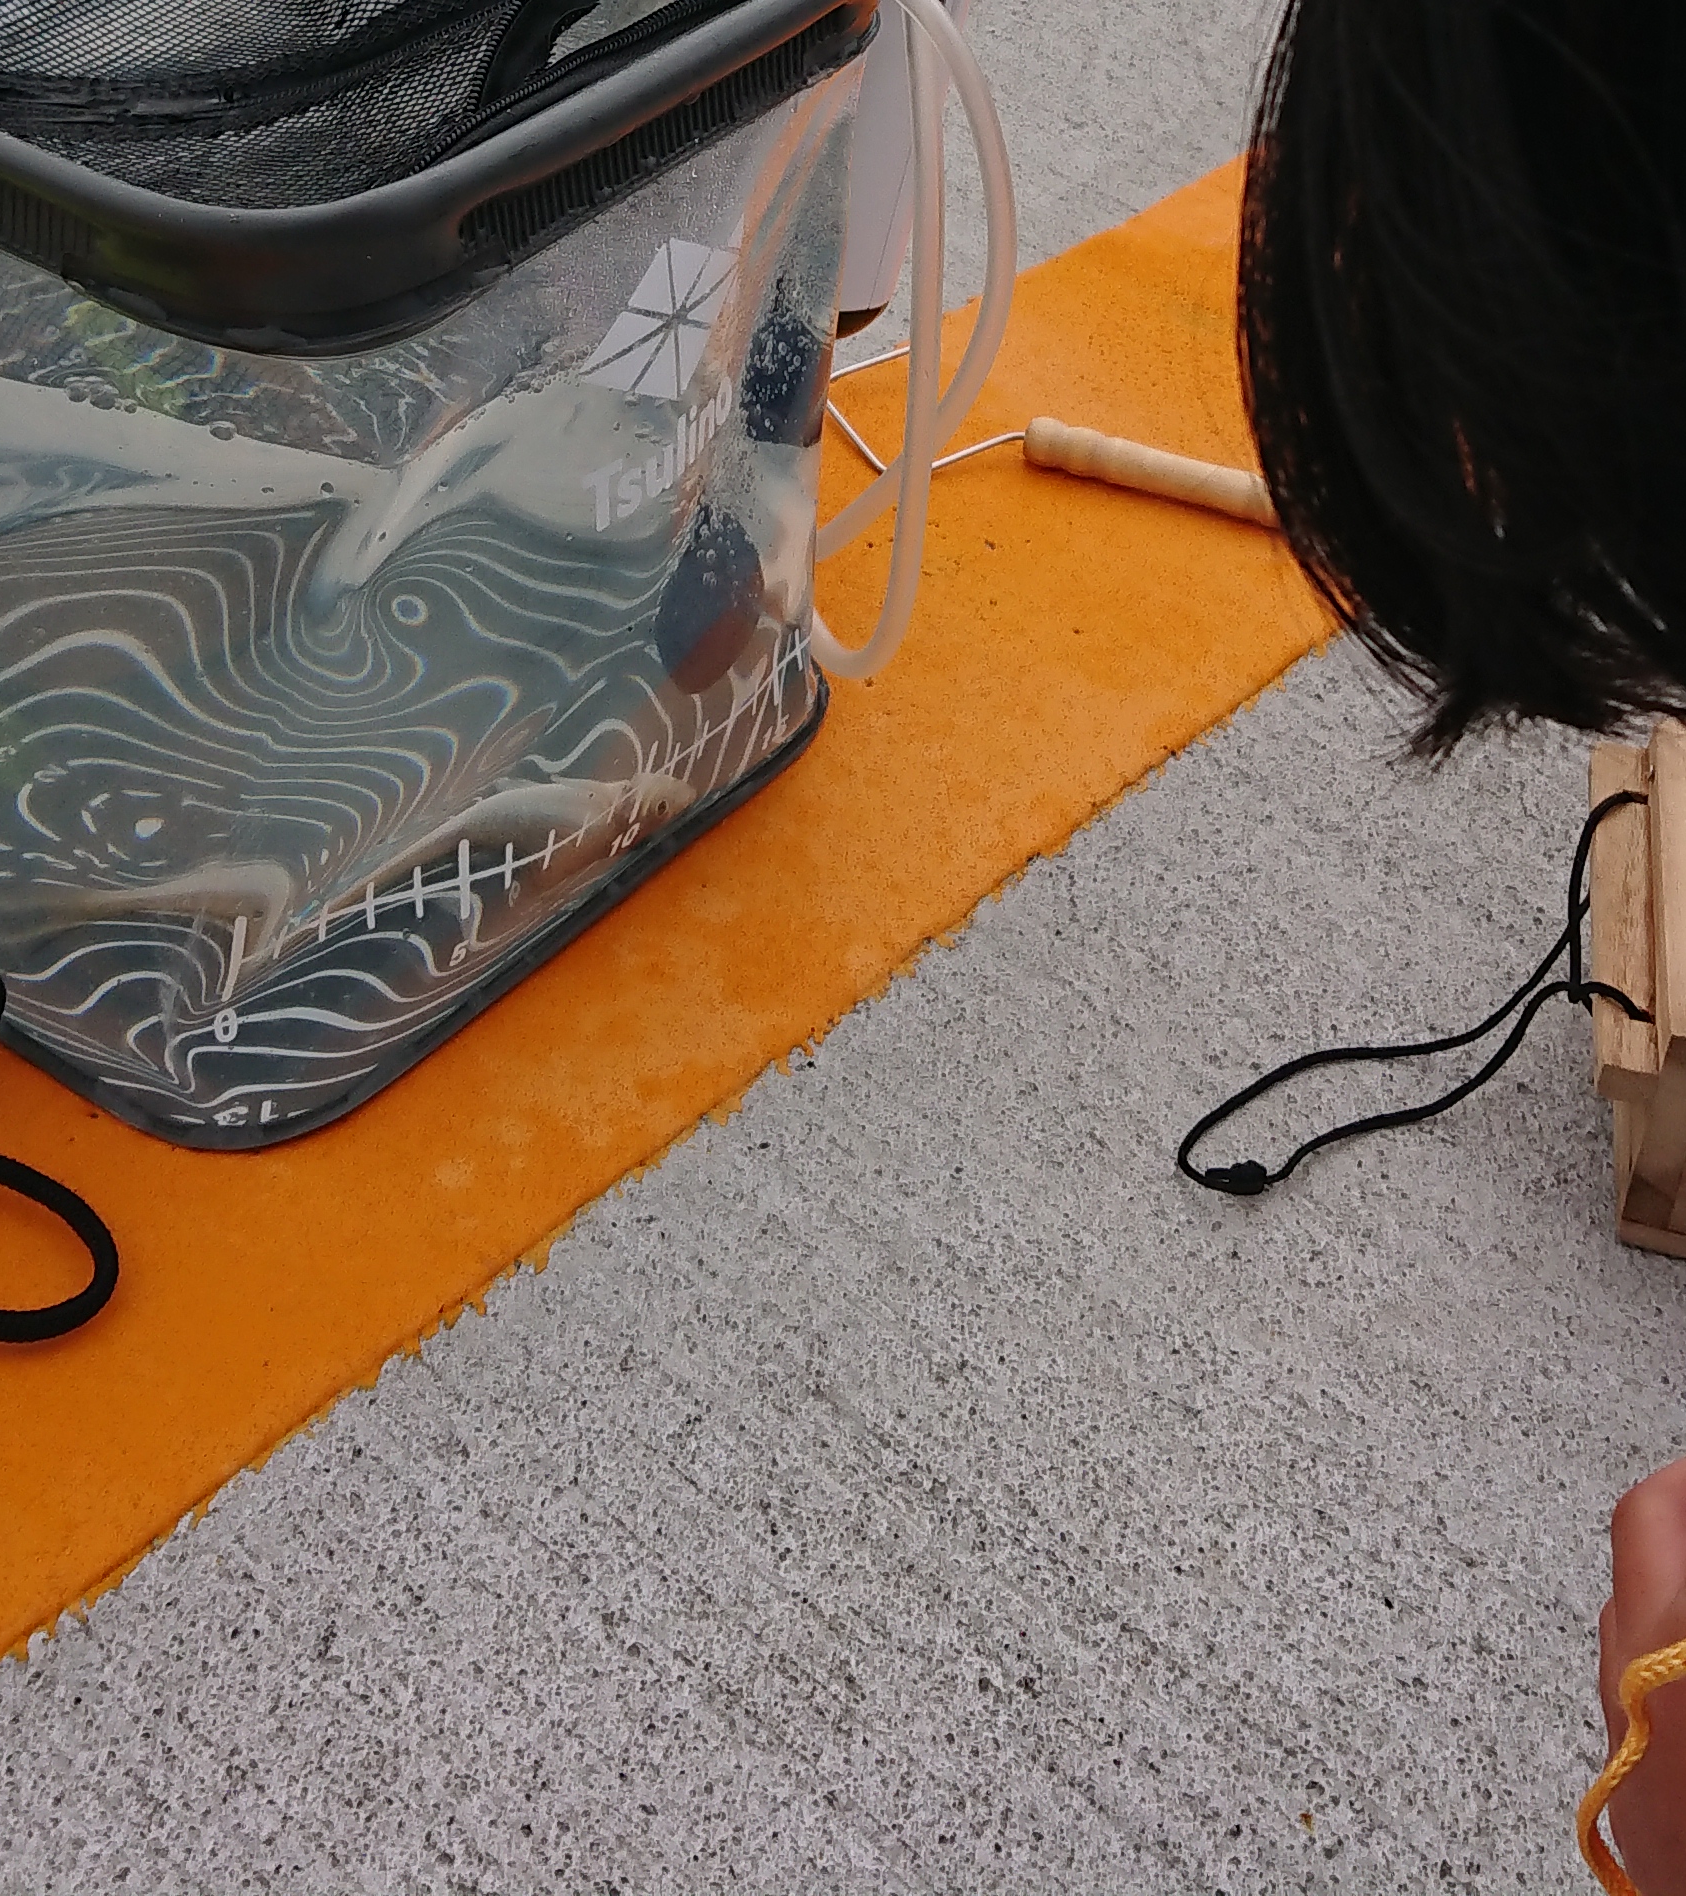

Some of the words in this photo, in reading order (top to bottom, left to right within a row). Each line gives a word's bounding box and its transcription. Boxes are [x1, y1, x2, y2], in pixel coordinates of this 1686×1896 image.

[581, 376, 733, 533] Tsulino
[214, 1008, 238, 1043] 0
[449, 939, 470, 967] 5
[608, 822, 641, 858] 10
